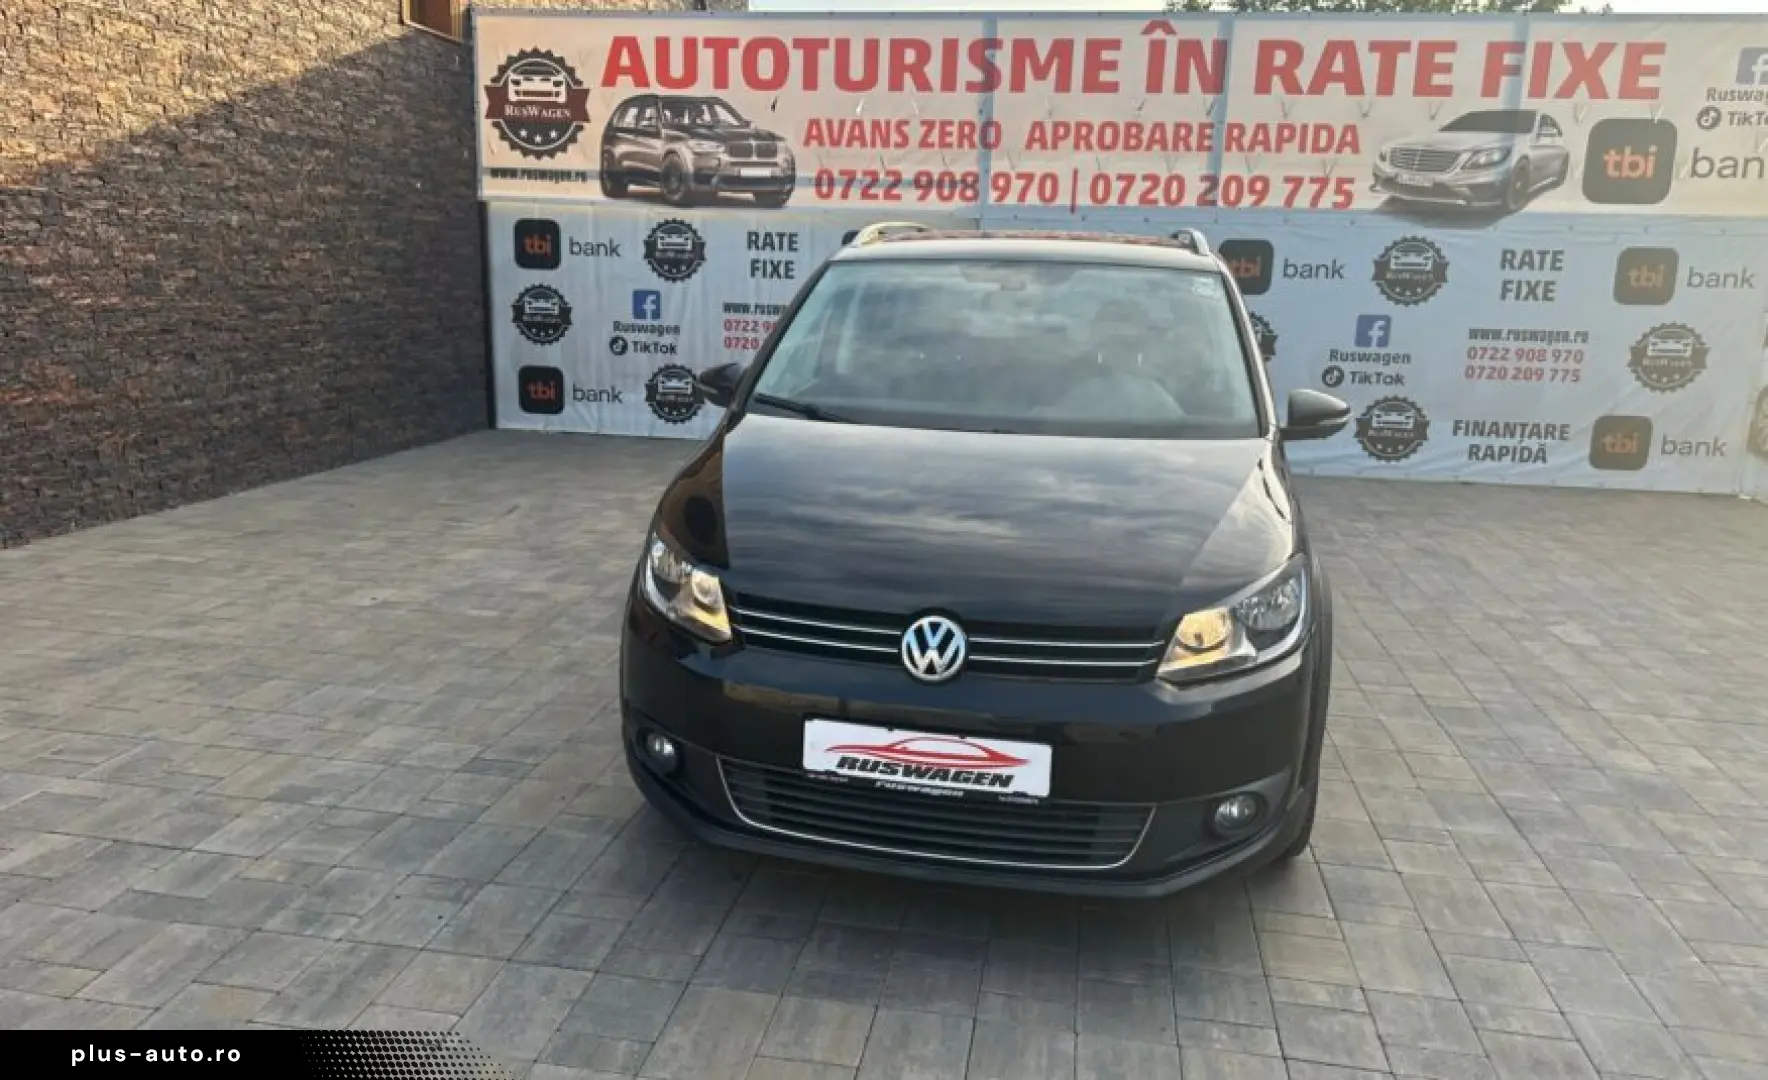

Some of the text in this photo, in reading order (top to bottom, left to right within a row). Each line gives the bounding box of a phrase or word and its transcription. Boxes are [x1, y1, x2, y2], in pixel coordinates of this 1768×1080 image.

[601, 19, 1668, 100] AUTOTURISME ÎN RATE FIXE
[803, 118, 1360, 154] AVANS ZERO APROBARE RAPIDA
[1603, 145, 1659, 178] tbi
[814, 168, 902, 200] 0722
[914, 170, 980, 202] 908
[990, 172, 1059, 204] 970
[1089, 172, 1186, 206] 0720
[1196, 174, 1270, 208] 209
[1282, 176, 1355, 210] 775
[568, 236, 621, 257] bank
[746, 231, 799, 252] RATE
[750, 258, 796, 280] FIXE
[1282, 258, 1346, 280] bank
[1499, 249, 1565, 272] RATE
[1627, 264, 1756, 289] tbi bank
[1500, 280, 1557, 302] FIXE
[632, 340, 678, 356] TikTok
[1329, 349, 1412, 366] Ruswagen
[1466, 346, 1585, 364] 0722 908 970
[1349, 370, 1405, 387] TikTok
[1464, 365, 1582, 384] 0720 209 775
[572, 382, 623, 404] bank
[1601, 433, 1728, 458] tbi bank
[836, 755, 1015, 788] RUSWAGEN
